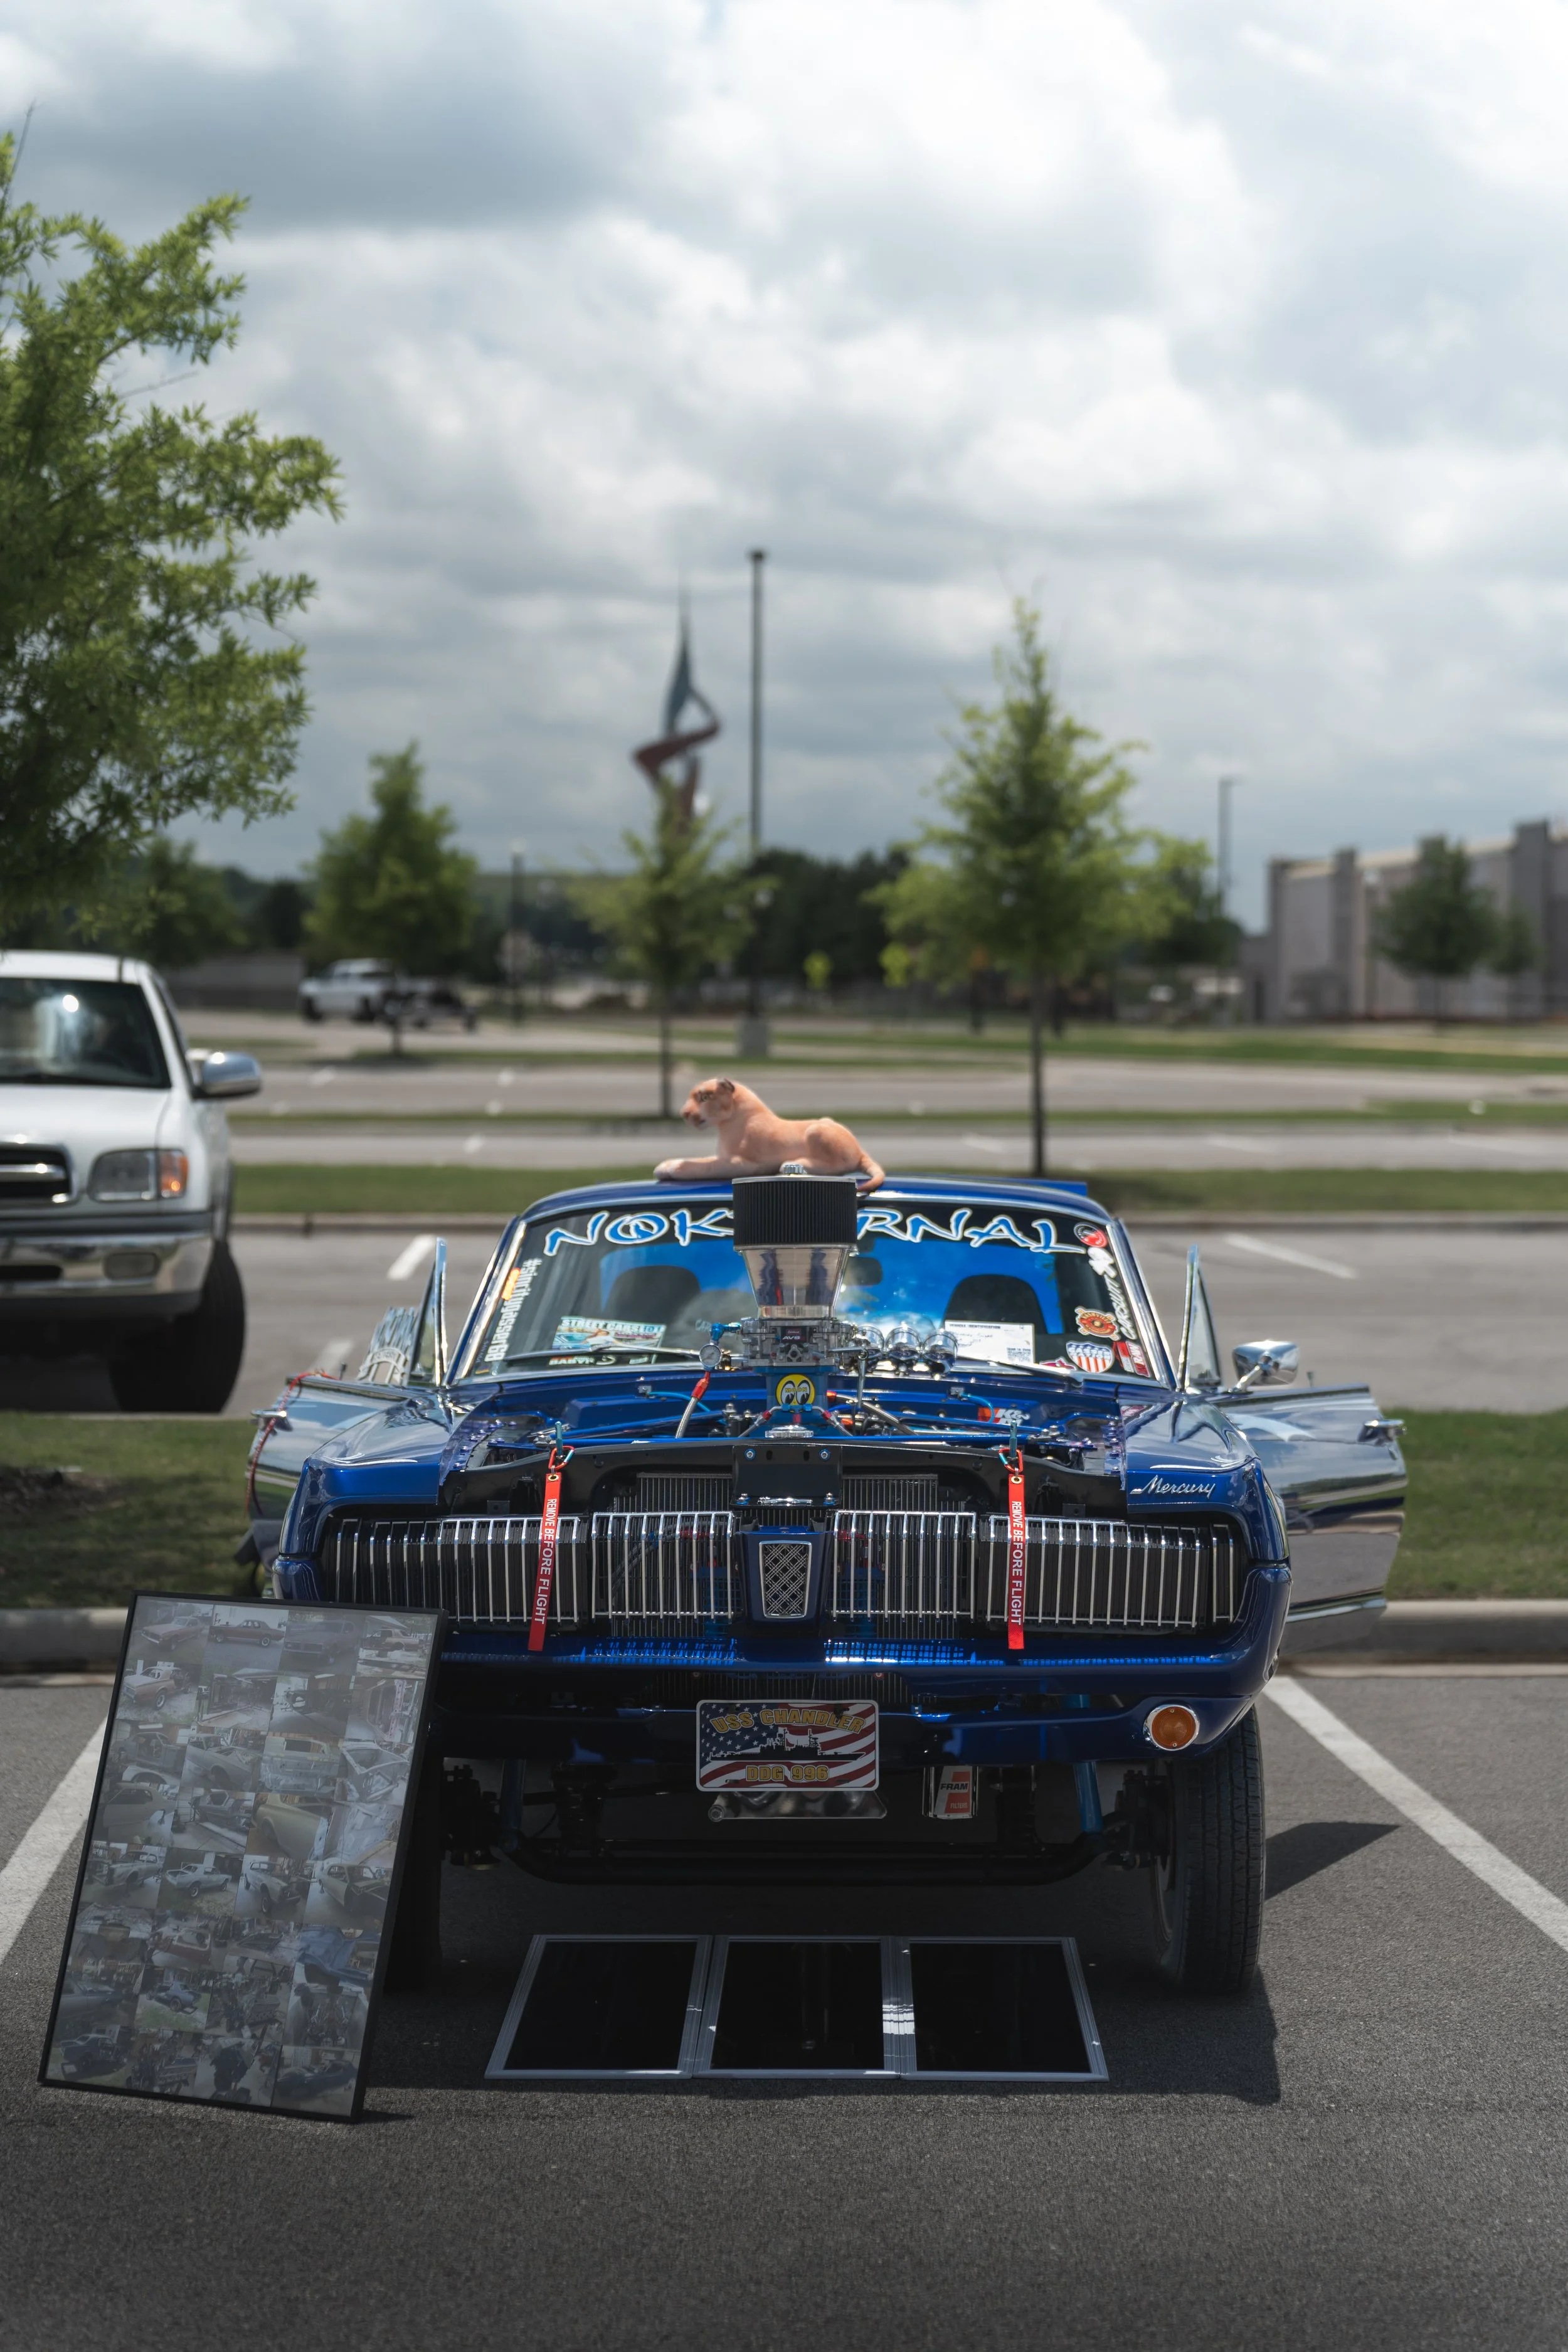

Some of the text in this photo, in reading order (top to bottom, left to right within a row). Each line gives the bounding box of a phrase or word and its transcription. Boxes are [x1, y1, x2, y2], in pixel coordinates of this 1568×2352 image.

[1130, 1475, 1216, 1500] Mercury
[534, 1498, 556, 1624] REMOVE BEFORE FLIGHT
[1011, 1501, 1024, 1626] REMOVE BEFORE FLIGHT
[710, 1708, 867, 1734] USS CHANDLER
[745, 1765, 830, 1782] DDG 996
[941, 1783, 968, 1791] FRAM
